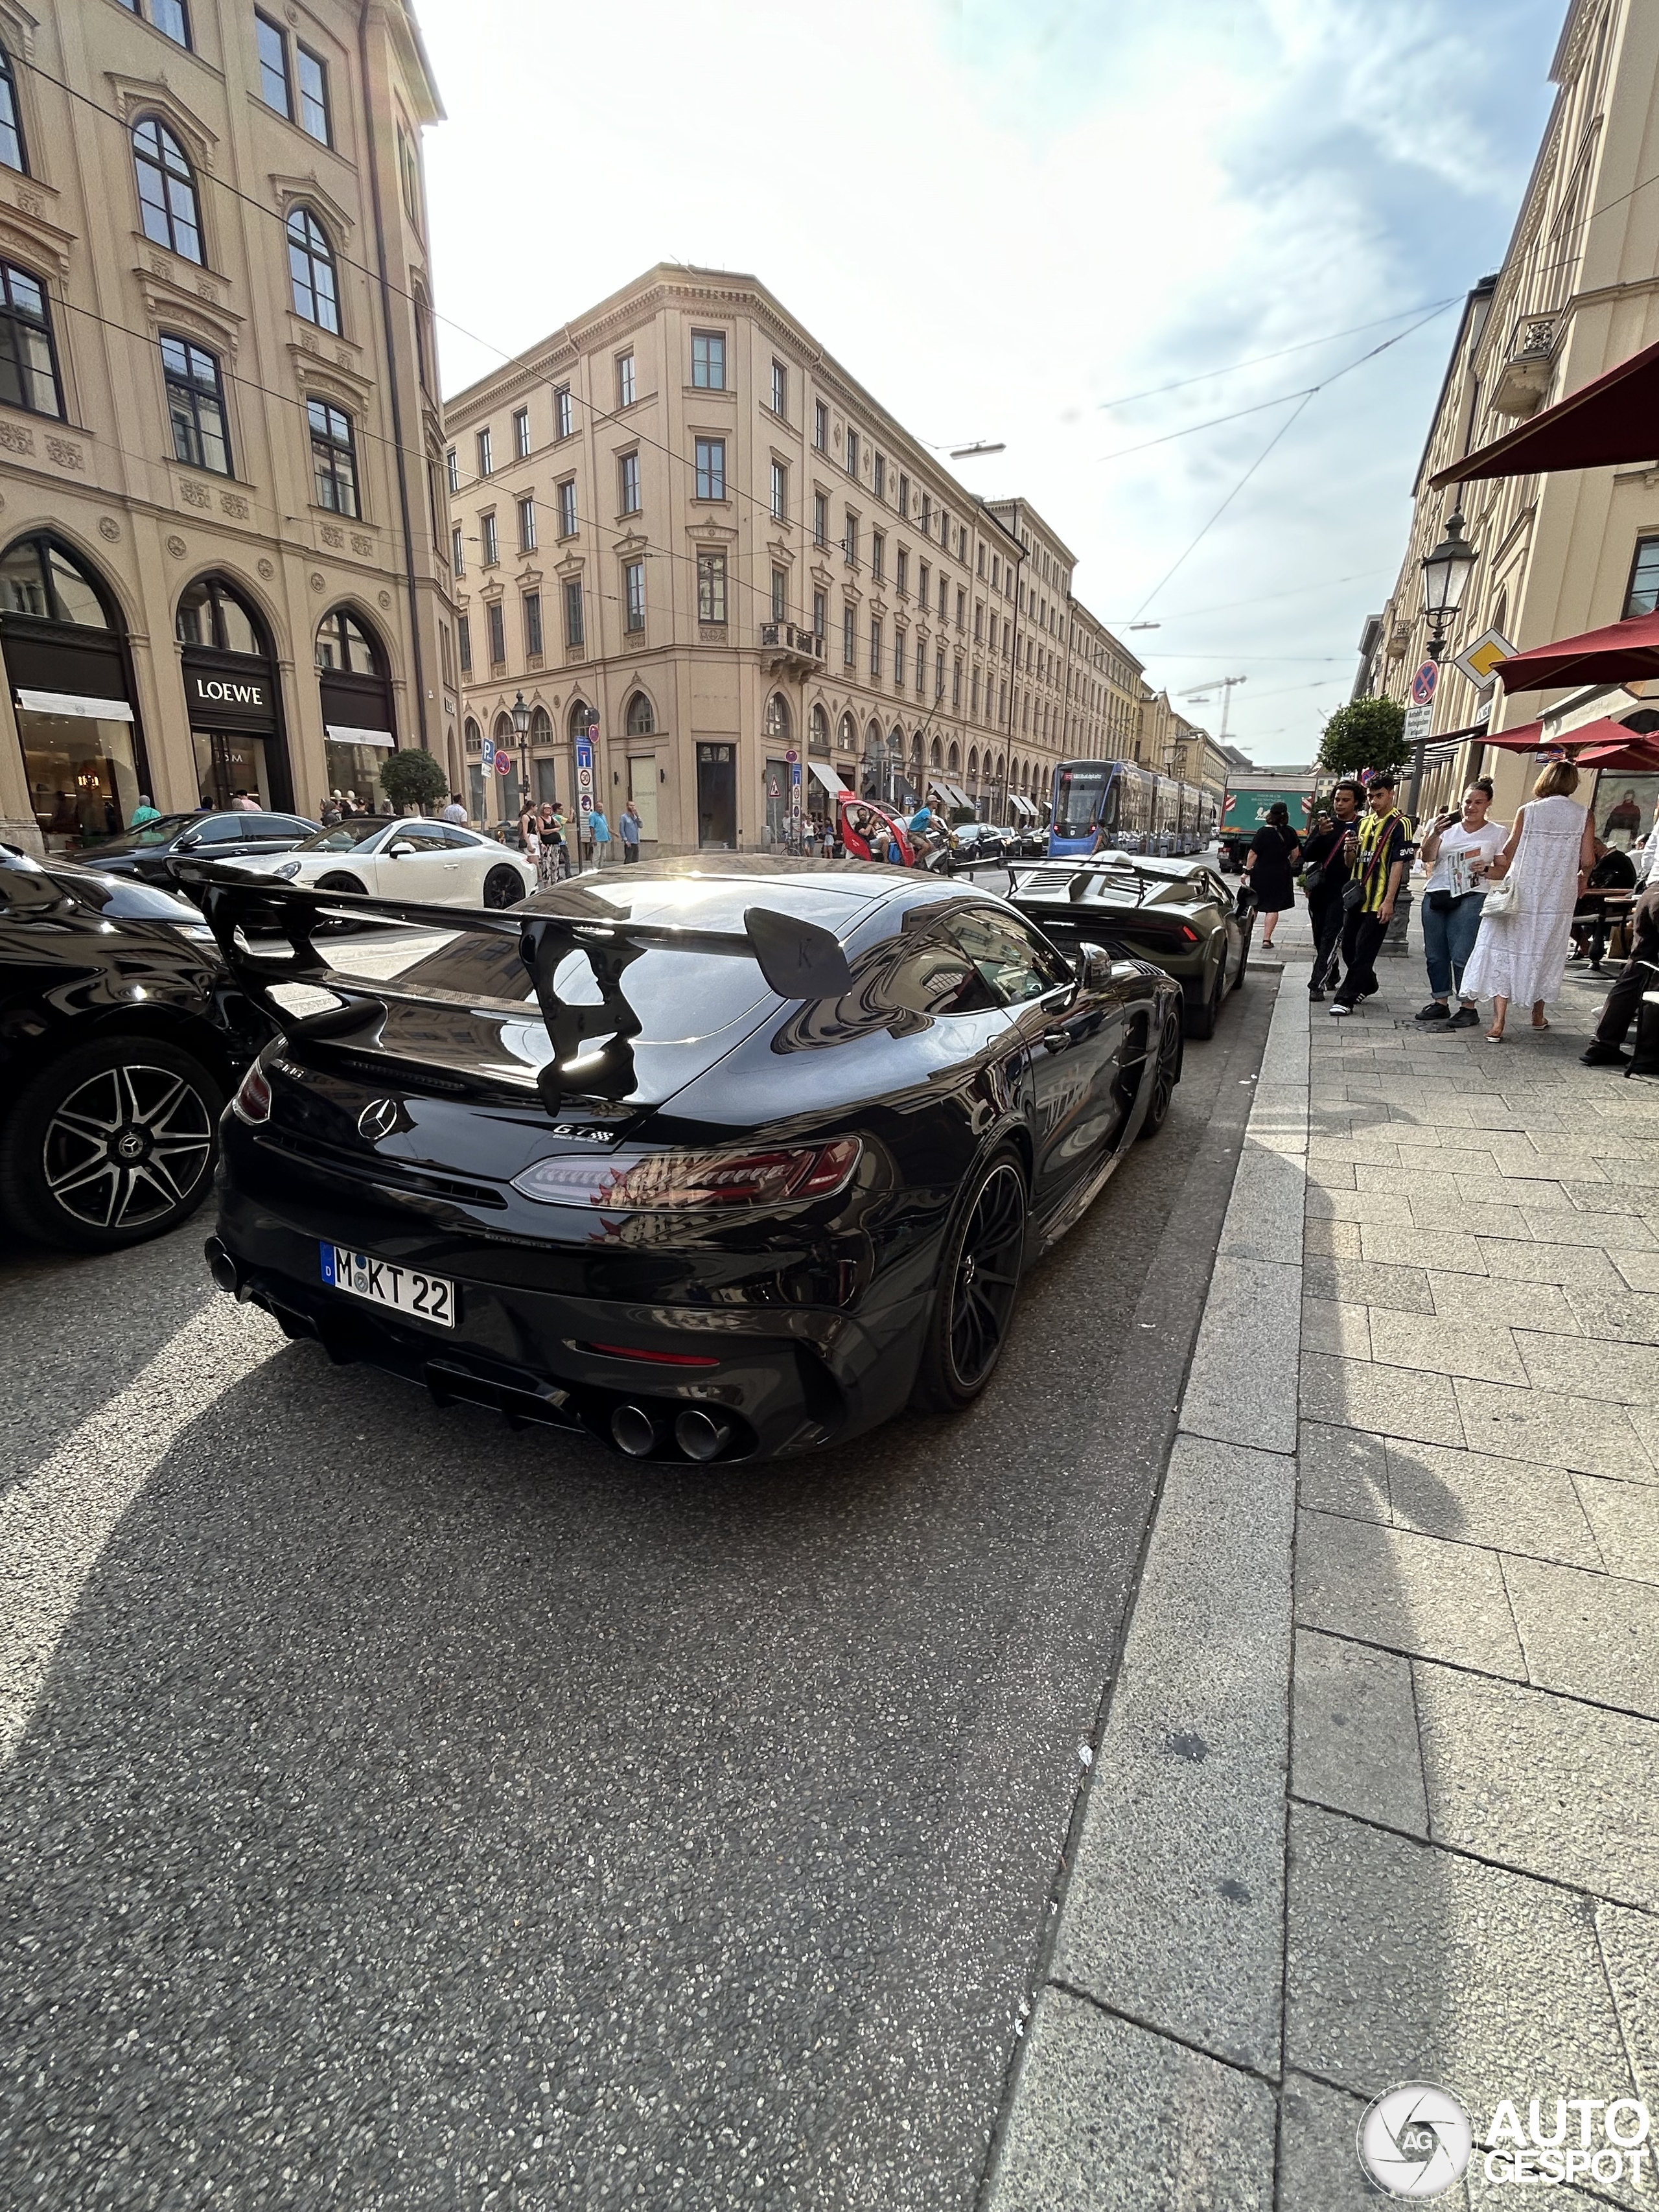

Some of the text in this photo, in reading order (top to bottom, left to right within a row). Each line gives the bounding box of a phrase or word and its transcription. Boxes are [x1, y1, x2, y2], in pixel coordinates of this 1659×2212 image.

[197, 679, 263, 705] LOEWE
[484, 741, 491, 760] P
[553, 1124, 596, 1135] GT
[325, 1266, 331, 1276] D
[336, 1248, 448, 1320] M KT 22
